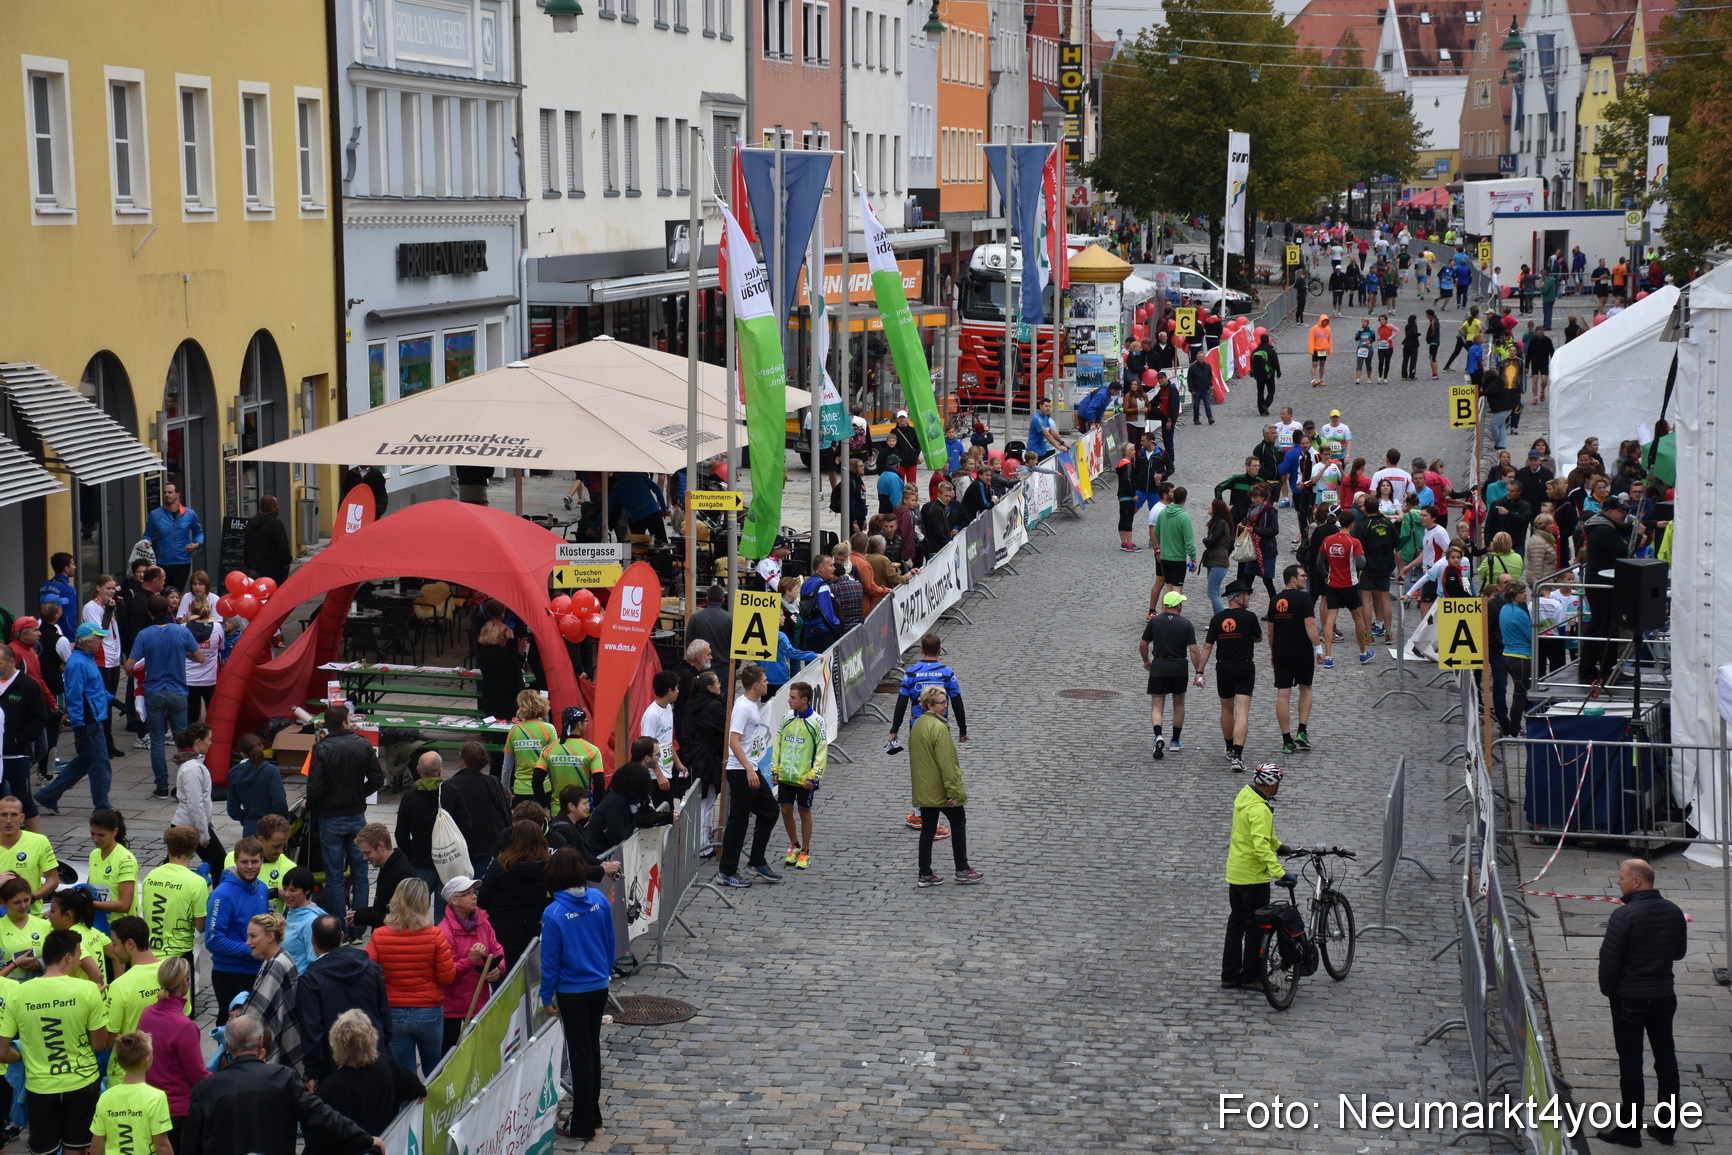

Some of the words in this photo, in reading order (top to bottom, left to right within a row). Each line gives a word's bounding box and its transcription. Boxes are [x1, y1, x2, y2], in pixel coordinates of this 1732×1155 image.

[395, 11, 432, 46] BRILLEN
[432, 18, 467, 50] WEBER
[1062, 46, 1082, 161] HOTEL
[406, 243, 450, 278] BRILLEN
[450, 240, 488, 274] WEBER
[1180, 316, 1190, 330] C
[1452, 387, 1476, 396] Block
[1457, 398, 1472, 419] B
[408, 433, 530, 446] Neumarkter
[375, 442, 544, 459] Lammsbräu
[347, 522, 360, 531] DKMS
[560, 546, 615, 558] Klostergasse
[574, 569, 602, 577] Duschen
[740, 593, 777, 608] Block
[1443, 600, 1482, 614] Block
[622, 608, 640, 619] DKMS
[741, 612, 768, 647] A
[1449, 619, 1478, 654] A
[604, 642, 637, 653] www.dkms.de
[513, 739, 543, 748] BOCK
[550, 755, 585, 763] BOCK
[147, 879, 164, 887] Team
[165, 881, 183, 891] Partl
[150, 892, 168, 951] BMW
[139, 987, 160, 999] Team
[25, 1001, 51, 1012] Team
[53, 998, 76, 1008] Partl
[40, 1016, 73, 1076] BMW
[107, 1109, 127, 1118] Team
